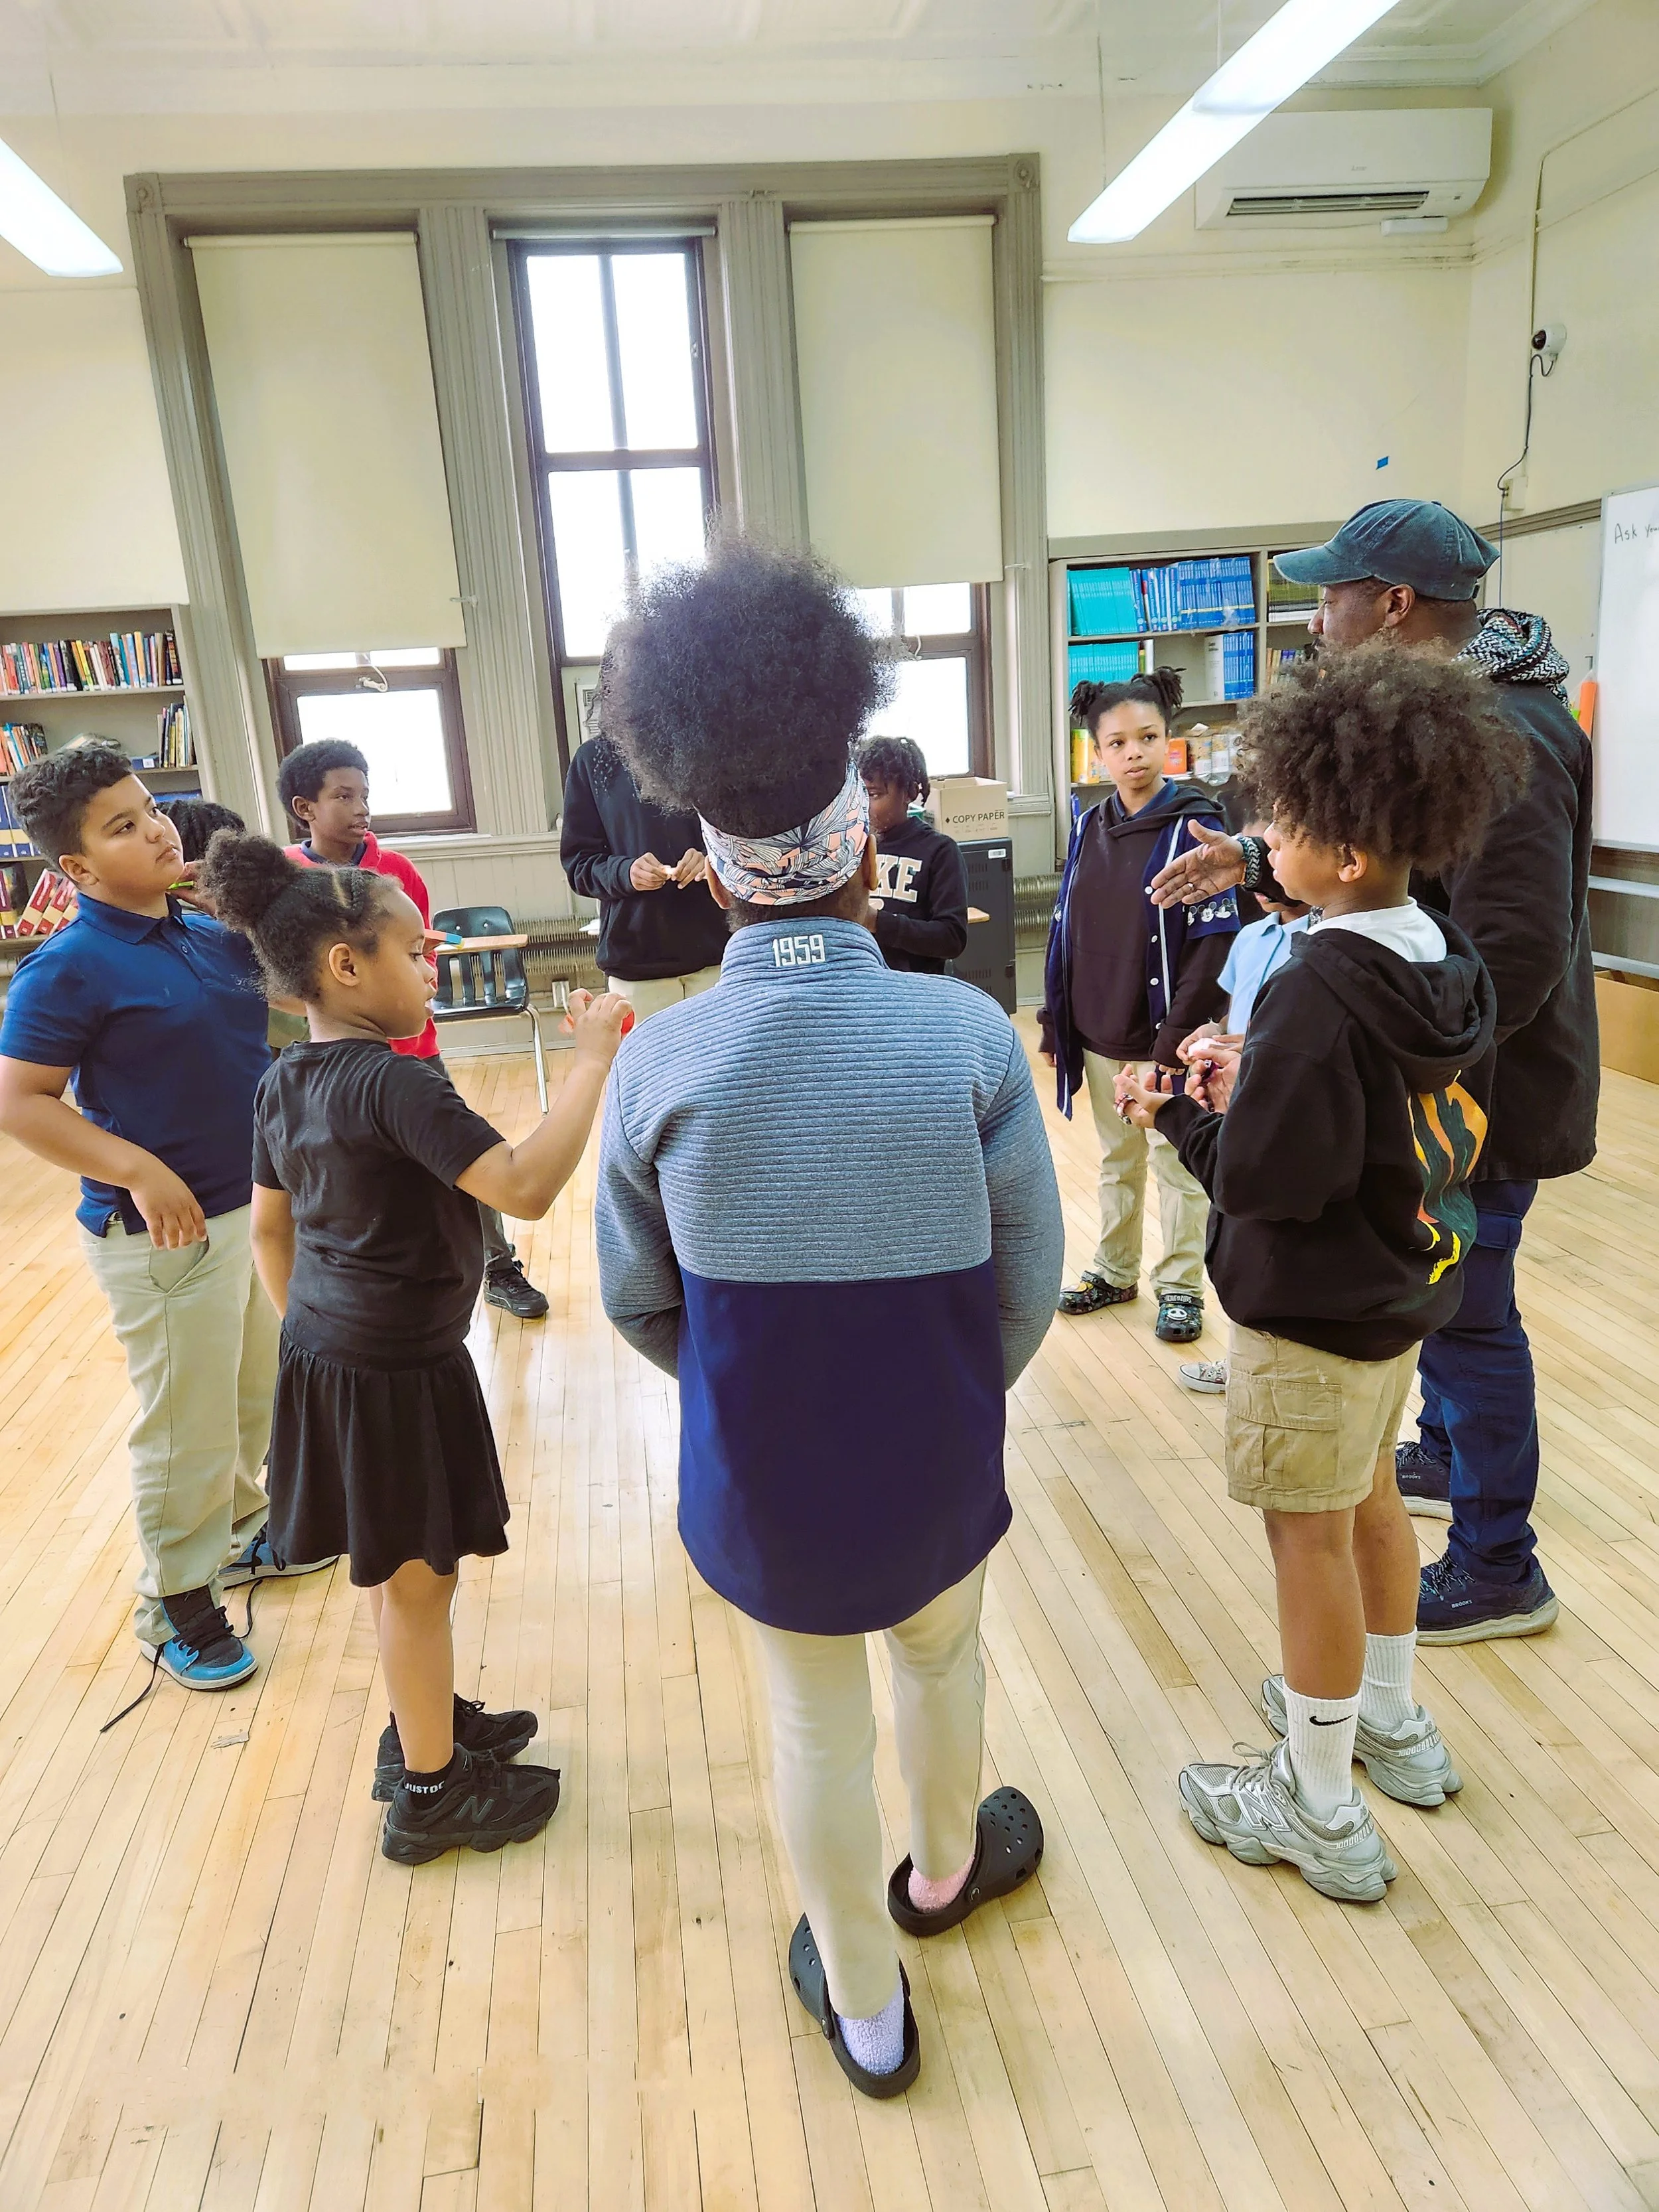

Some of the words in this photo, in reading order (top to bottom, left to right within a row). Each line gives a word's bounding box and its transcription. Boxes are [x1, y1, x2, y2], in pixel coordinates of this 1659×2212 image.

[1615, 523, 1637, 544] Ask
[952, 814, 975, 824] COPY
[977, 811, 1005, 821] PAPER
[869, 853, 922, 903] KE
[772, 934, 826, 968] 1959
[1451, 1599, 1473, 1608] BROOKS
[404, 1783, 429, 1794] JUST
